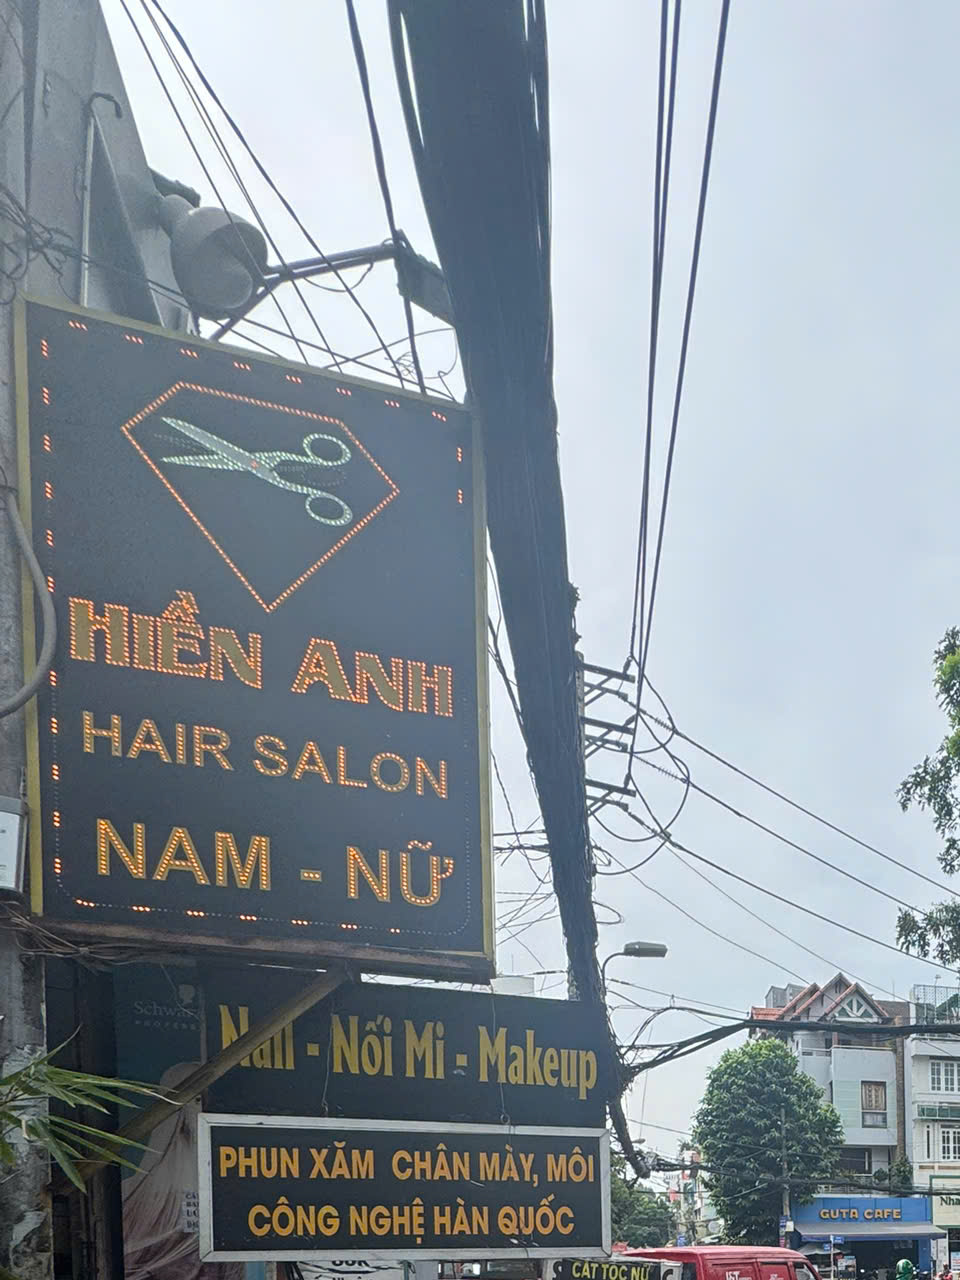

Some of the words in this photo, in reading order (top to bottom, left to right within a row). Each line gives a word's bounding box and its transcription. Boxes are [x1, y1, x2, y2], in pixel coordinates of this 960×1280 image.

[68, 590, 263, 690] HIỀN
[290, 636, 453, 717] ANH
[82, 711, 234, 771] HAIR
[253, 734, 448, 799] SALON
[96, 818, 271, 891] NAM
[346, 840, 455, 907] NỮ
[331, 1013, 393, 1077] Nối
[404, 1019, 445, 1079] Mi
[478, 1025, 598, 1100] Makeup
[219, 1145, 300, 1178] PHUN
[309, 1141, 375, 1179] XĂM
[392, 1142, 470, 1181] CHÂN
[479, 1143, 539, 1187] MÀY,
[547, 1146, 594, 1182] MÔI
[248, 1196, 341, 1237] CÔNG
[350, 1196, 425, 1245] NGHỆ
[434, 1196, 489, 1235] HÀN
[498, 1193, 575, 1236] QUỐC
[820, 1208, 858, 1219] GUTA
[864, 1208, 901, 1219] CAFE
[940, 1196, 960, 1206] Nha
